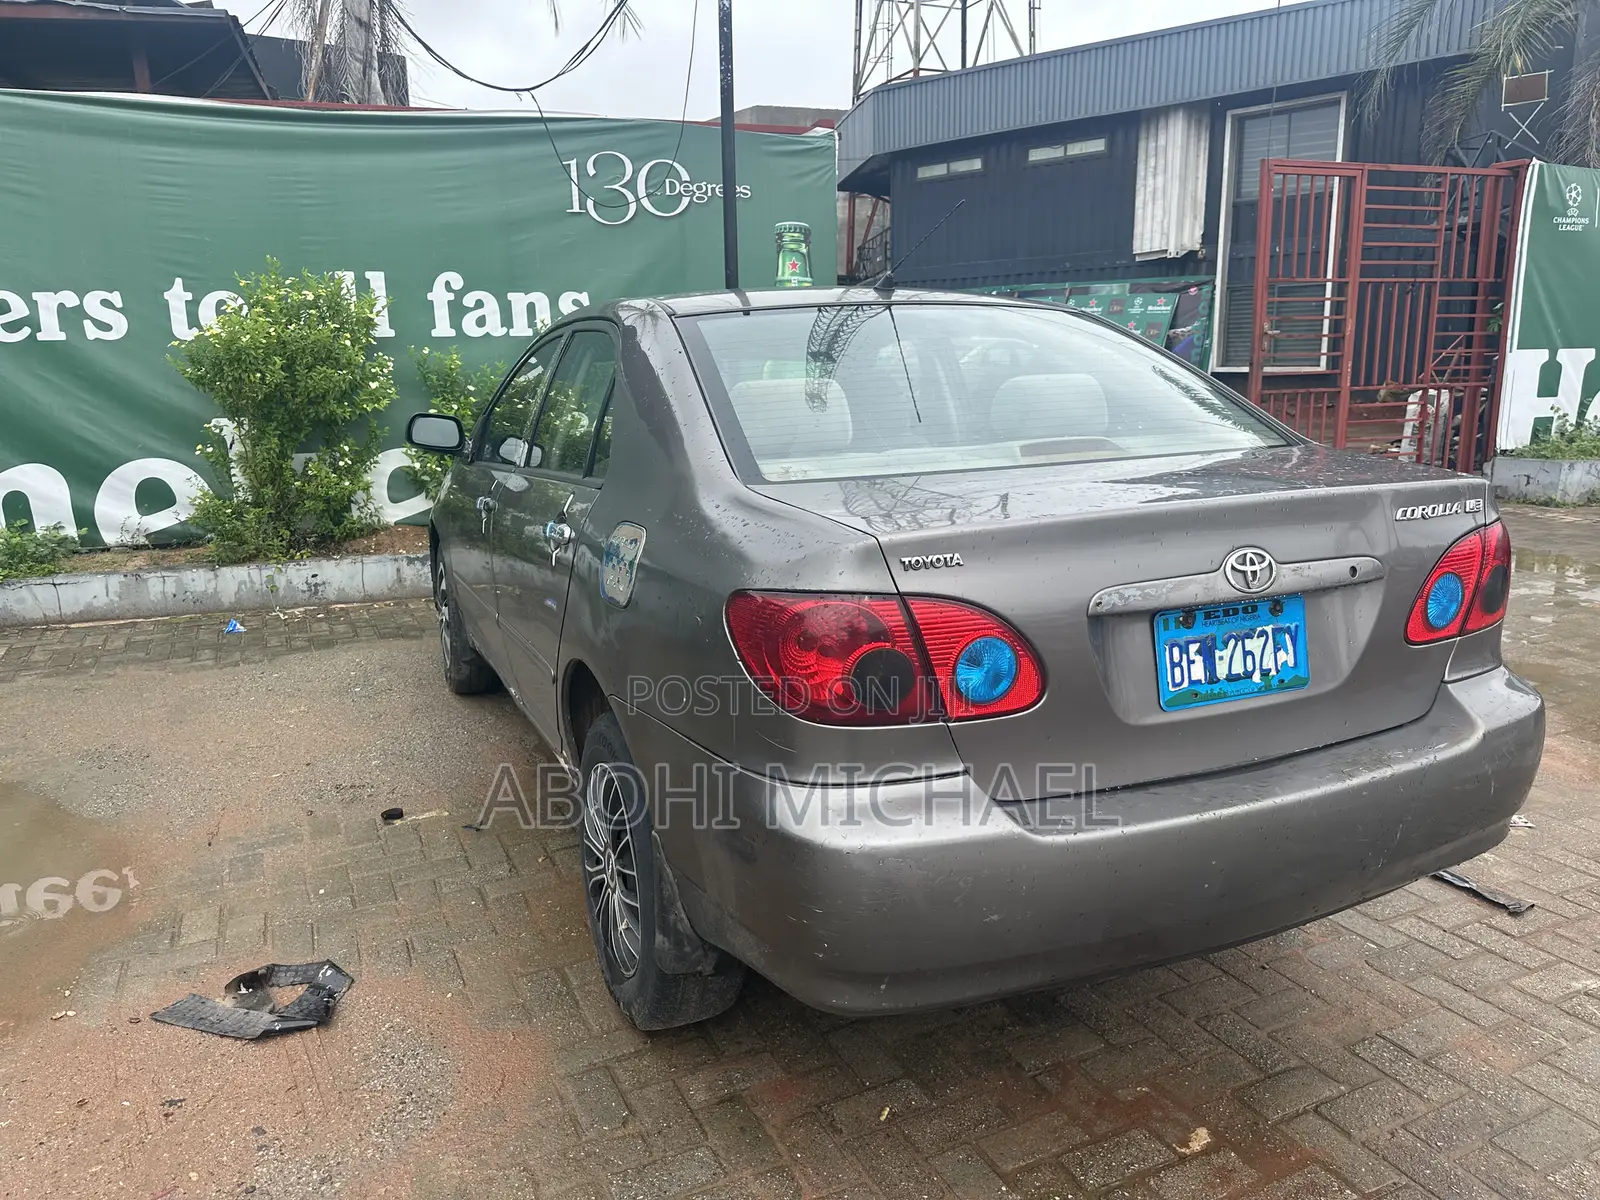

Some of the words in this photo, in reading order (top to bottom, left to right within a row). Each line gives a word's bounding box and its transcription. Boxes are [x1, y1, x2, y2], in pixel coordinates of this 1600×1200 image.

[562, 150, 691, 225] 130
[1553, 216, 1590, 225] CHAMPIONS
[1395, 502, 1462, 521] COROLLA
[900, 553, 964, 571] TOYOTA
[1203, 605, 1259, 621] EDO
